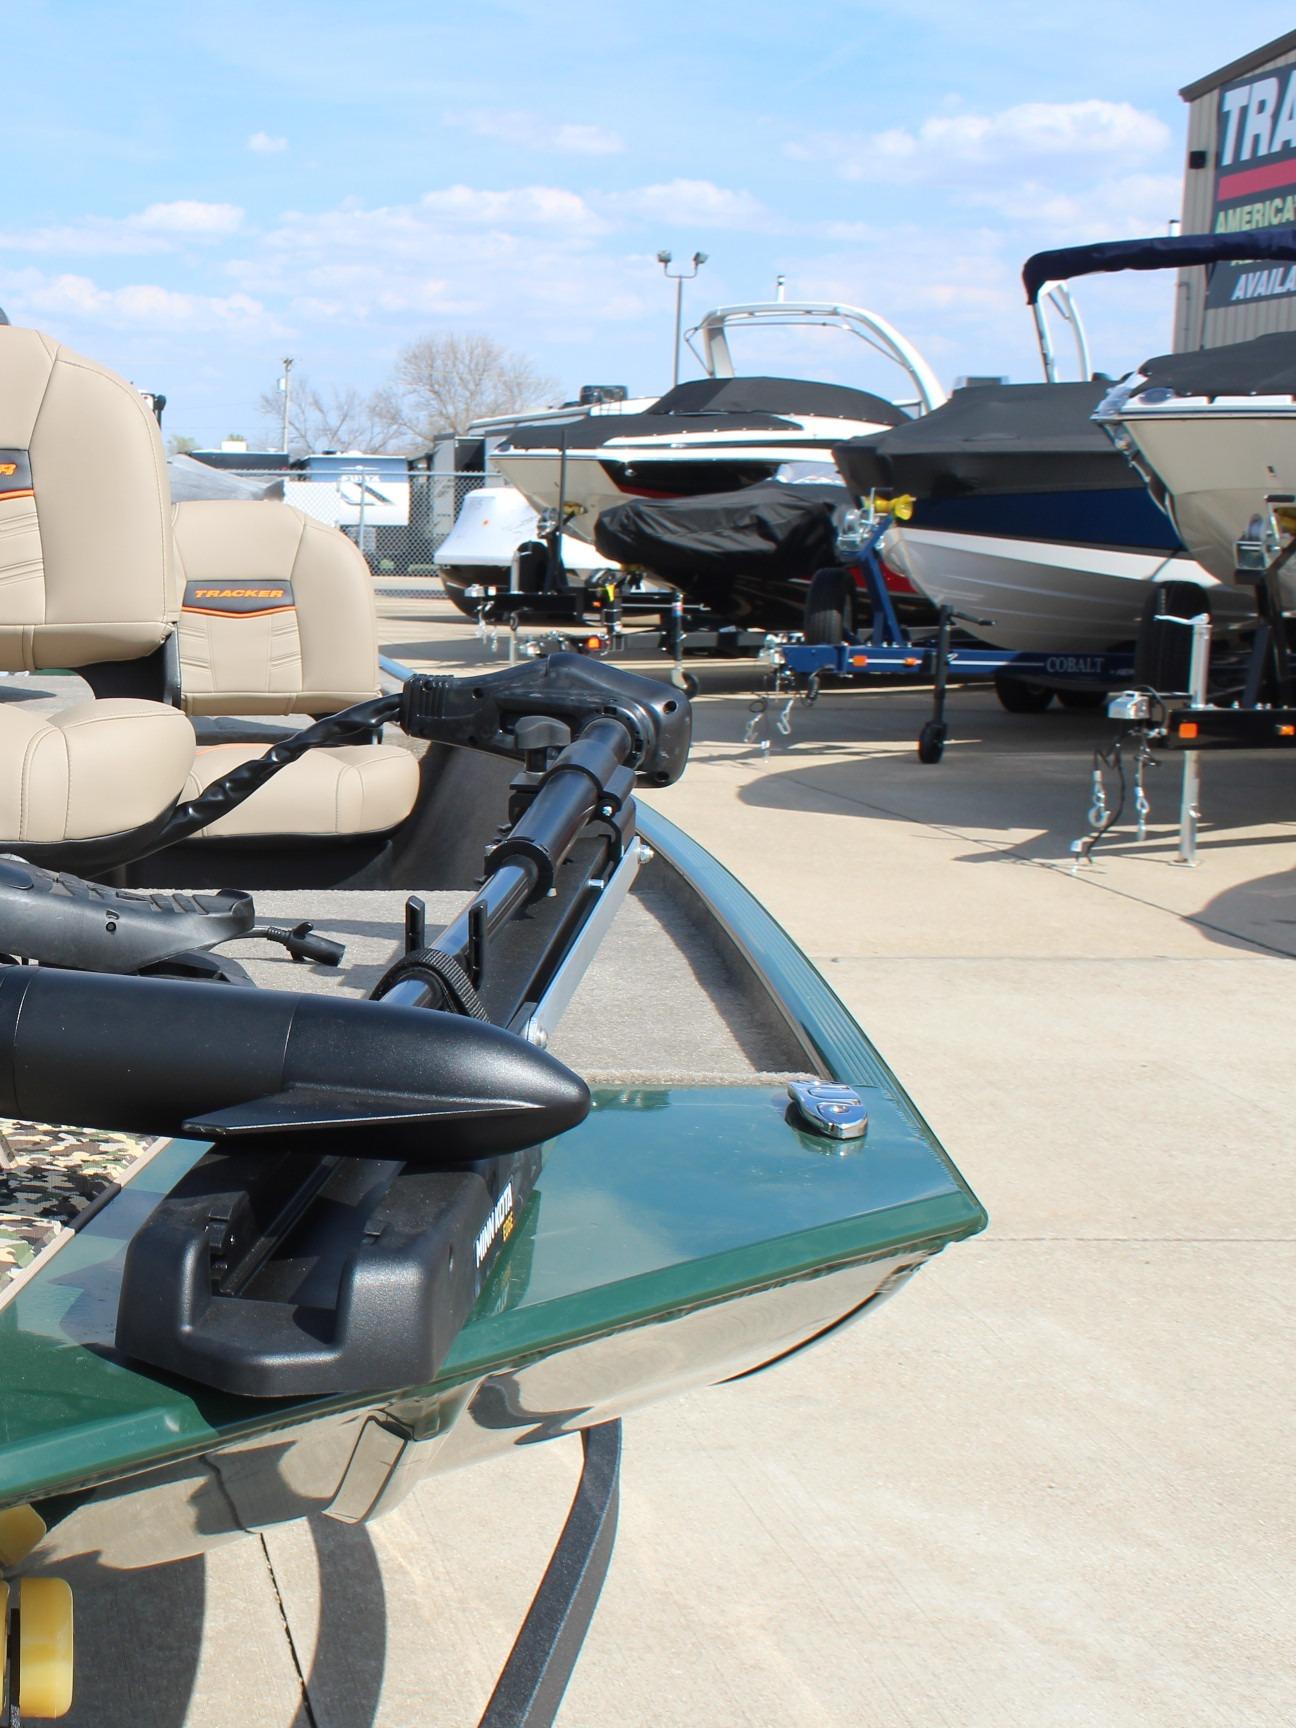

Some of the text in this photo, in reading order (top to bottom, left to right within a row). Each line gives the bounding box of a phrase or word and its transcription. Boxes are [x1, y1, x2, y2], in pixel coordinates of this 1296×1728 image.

[194, 589, 284, 599] TRACKER
[1046, 657, 1104, 672] COBALT
[476, 1181, 513, 1269] MINN KOTA
